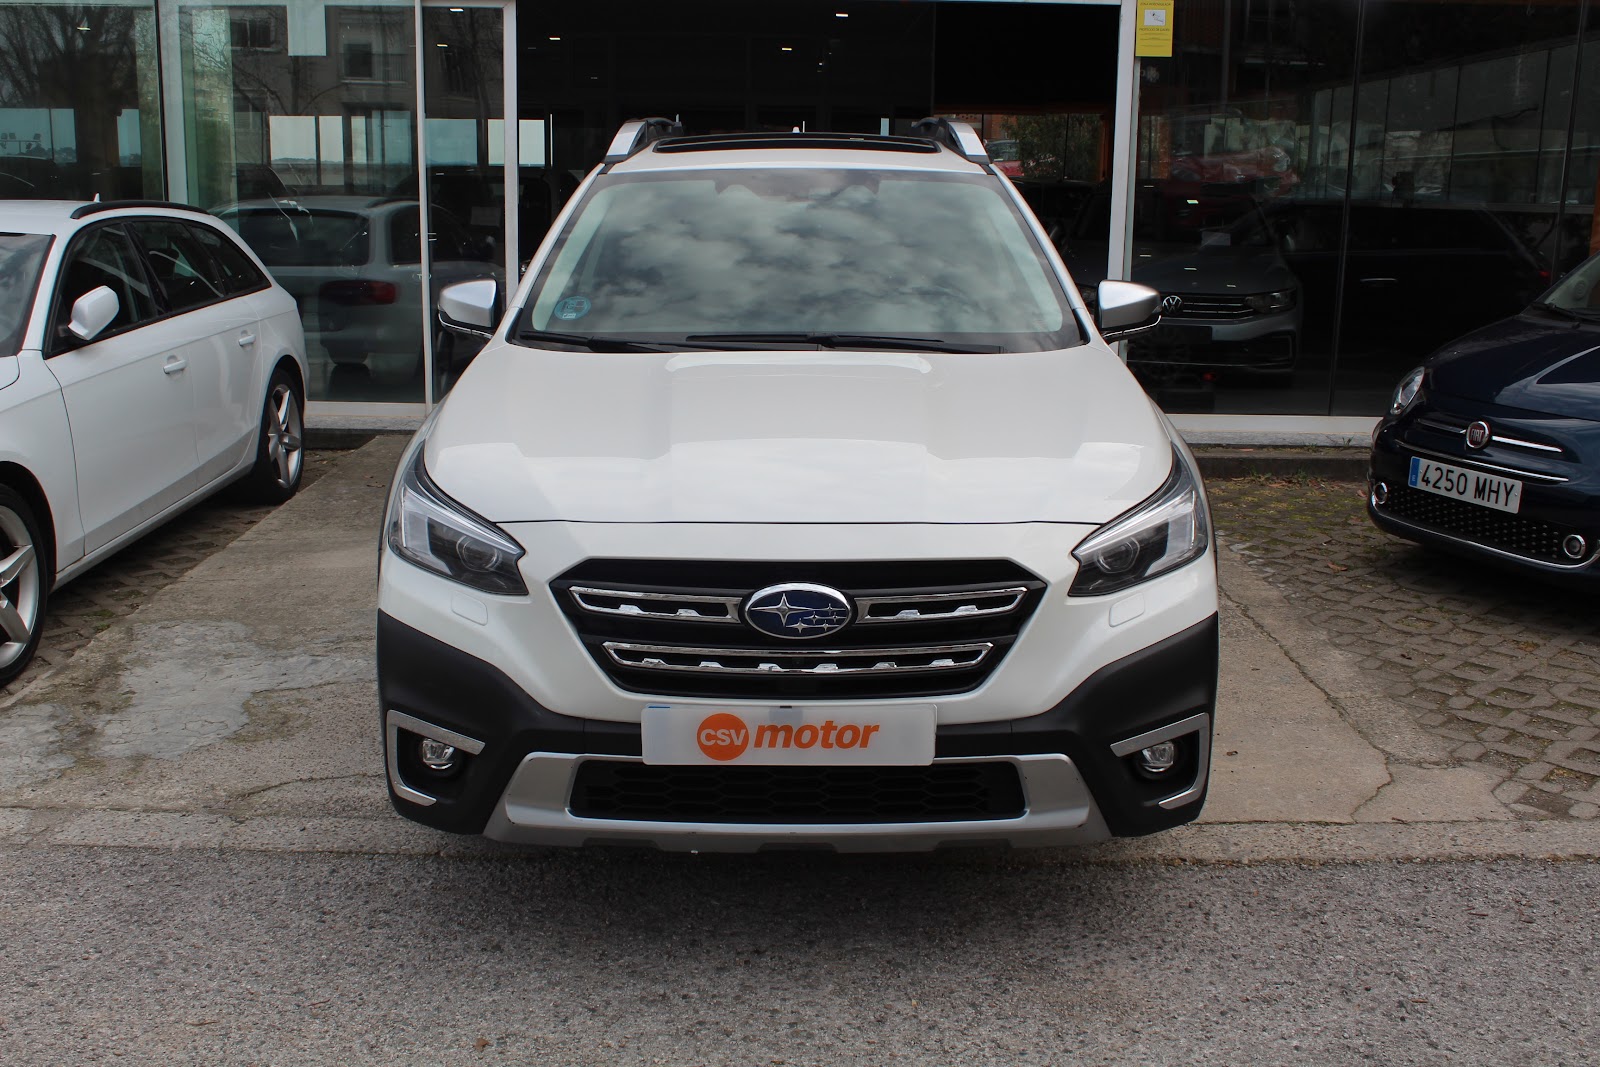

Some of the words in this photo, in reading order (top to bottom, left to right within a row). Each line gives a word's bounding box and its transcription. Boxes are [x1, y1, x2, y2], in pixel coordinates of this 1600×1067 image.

[1471, 428, 1484, 442] FIAT
[1421, 464, 1468, 495] 4250
[1473, 476, 1515, 507] MHY
[700, 728, 746, 746] CSV
[753, 720, 880, 749] motor
